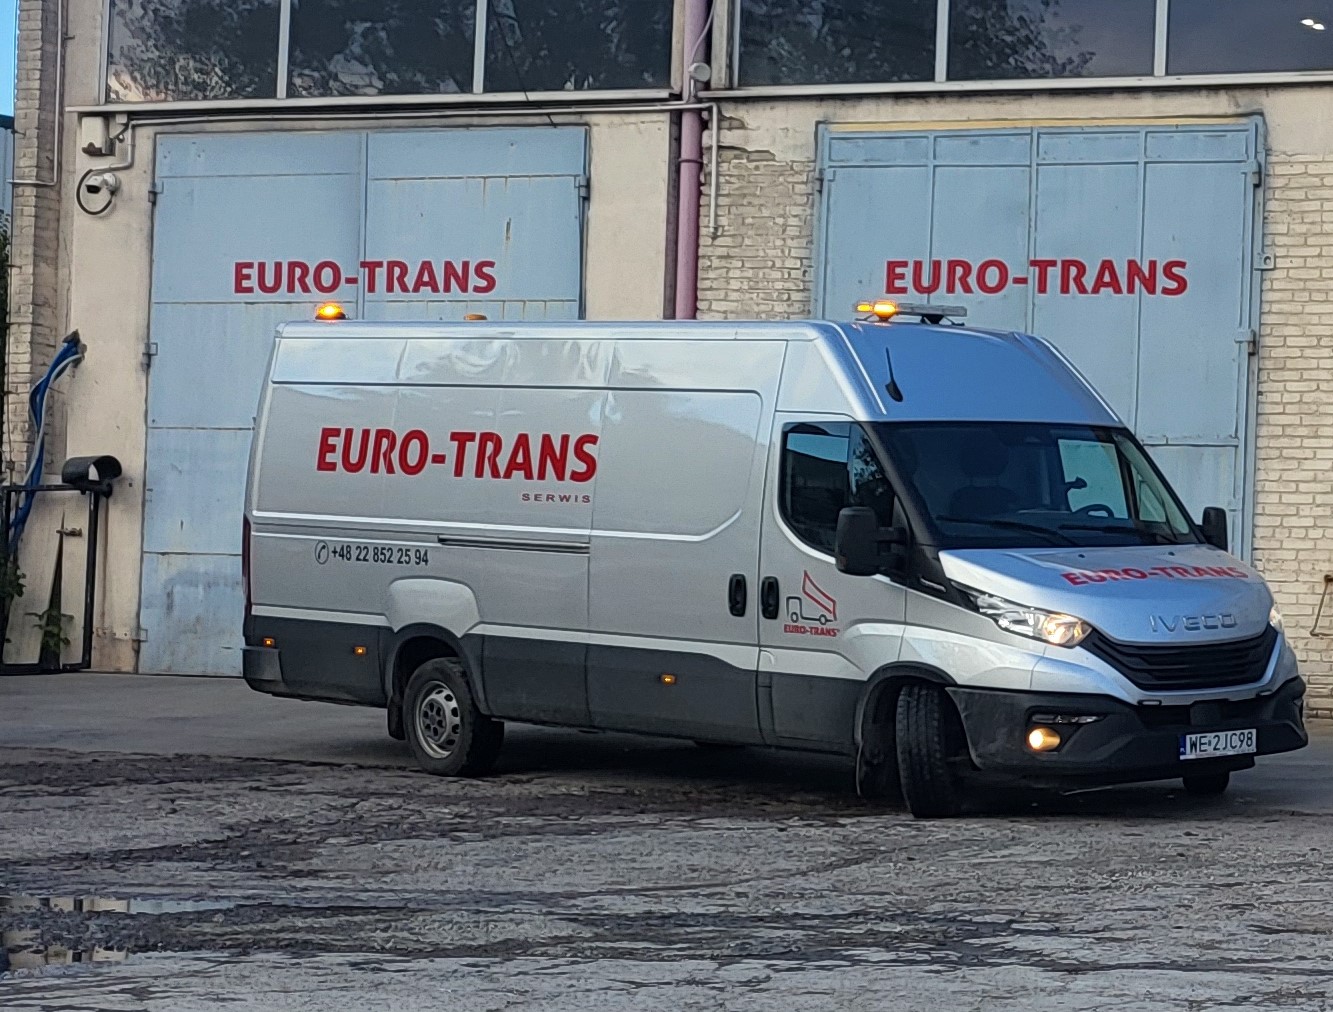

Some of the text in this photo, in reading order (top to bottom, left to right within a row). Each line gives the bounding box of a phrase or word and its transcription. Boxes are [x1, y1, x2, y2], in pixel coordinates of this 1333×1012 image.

[234, 260, 497, 294] EURO-TRANS
[885, 258, 1189, 296] EURO-TRANS
[316, 427, 600, 483] EURO-TRANS
[521, 493, 591, 503] SERWIS
[331, 545, 429, 565] +48 22 852 25 94
[1060, 566, 1248, 585] EURO-TRANS
[1150, 613, 1237, 633] IVECO
